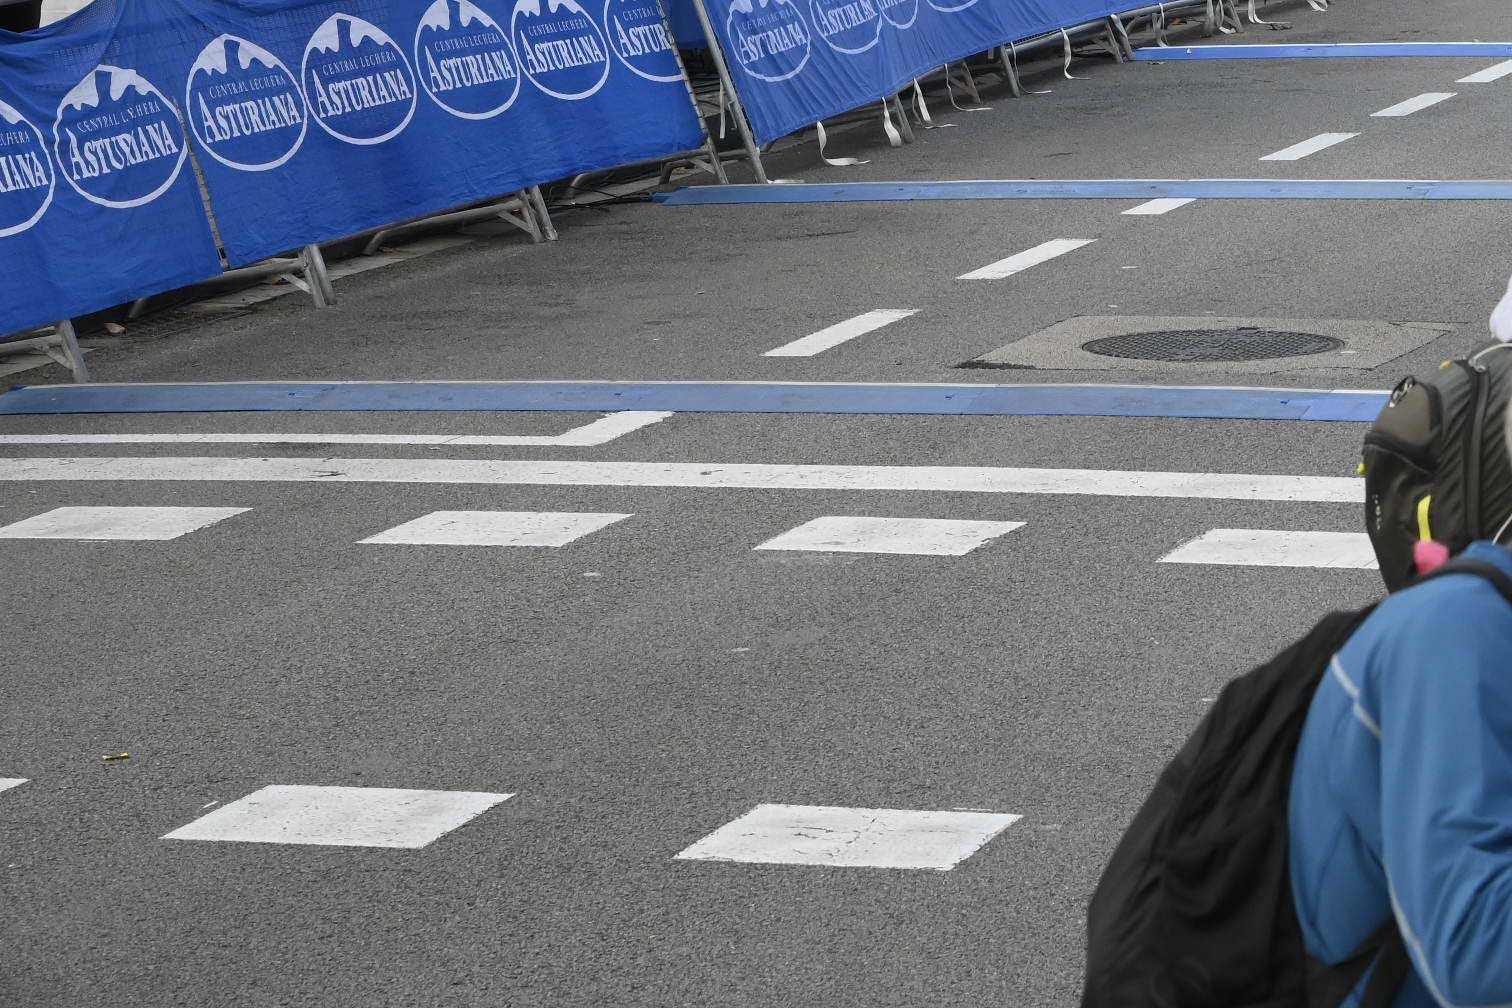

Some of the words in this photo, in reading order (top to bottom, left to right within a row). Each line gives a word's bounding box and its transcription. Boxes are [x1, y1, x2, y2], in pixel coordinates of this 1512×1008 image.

[528, 22, 557, 37] CENTRAL
[559, 18, 588, 33] LECHERA
[434, 37, 468, 52] CENTRAL
[470, 33, 500, 48] LECHERA
[520, 28, 605, 75] ASTURIANA
[322, 58, 357, 75] CENTRAL
[359, 50, 397, 67] LECHERA
[424, 46, 516, 93] ASTURIANA
[209, 80, 248, 99] CENTRAL
[250, 75, 286, 91] LECHERA
[312, 68, 412, 118] ASTURIANA
[76, 114, 119, 134] CENTRAL
[198, 92, 302, 144] ASTURIANA
